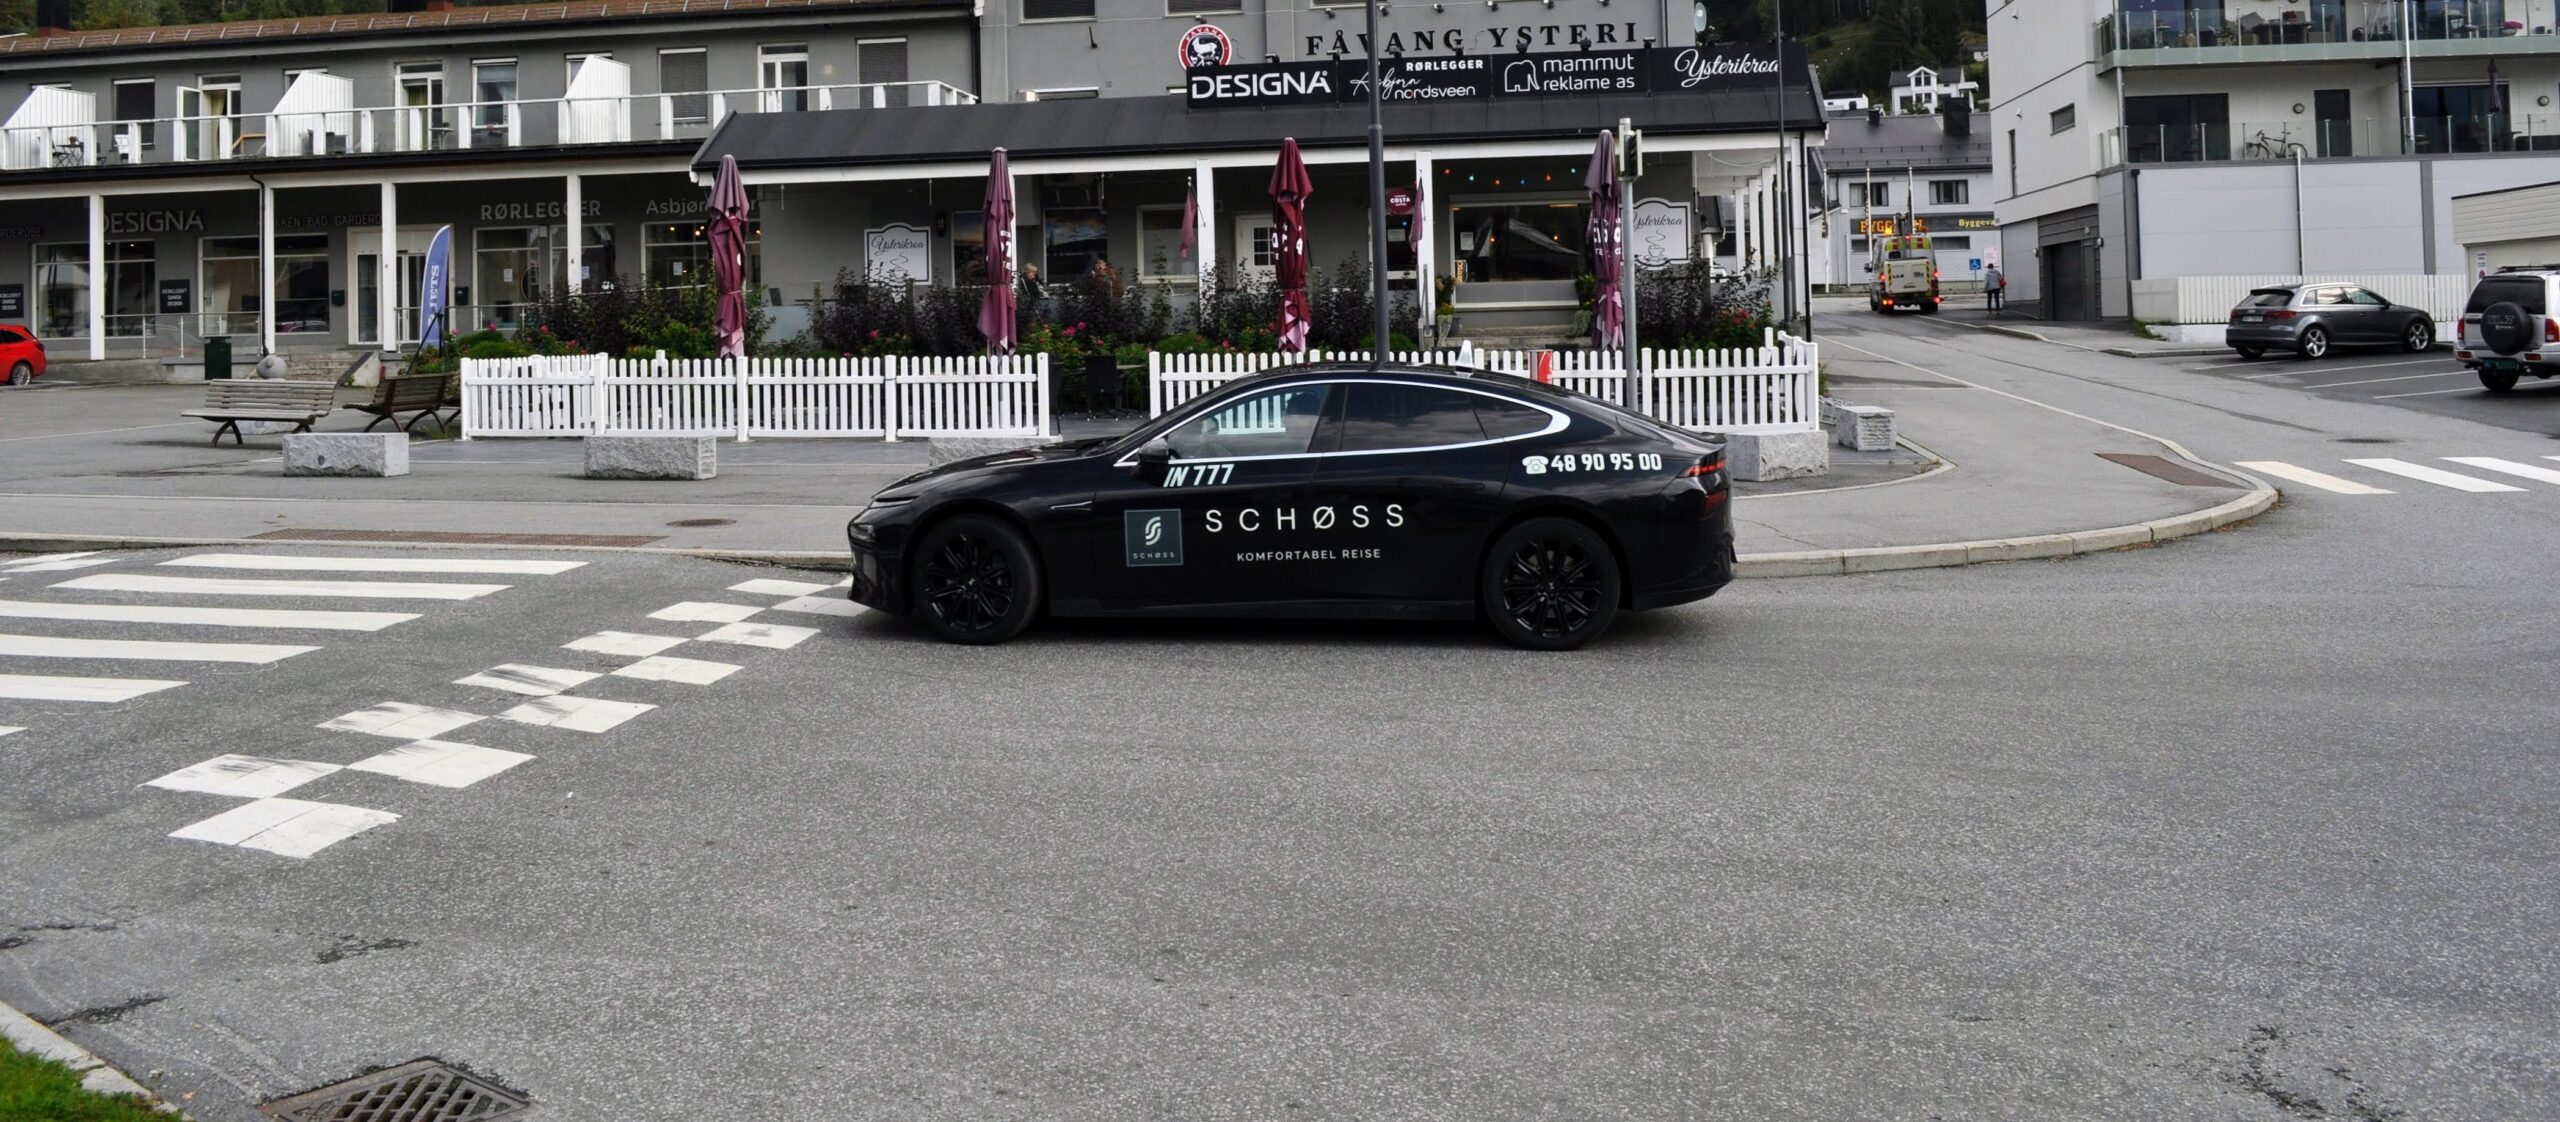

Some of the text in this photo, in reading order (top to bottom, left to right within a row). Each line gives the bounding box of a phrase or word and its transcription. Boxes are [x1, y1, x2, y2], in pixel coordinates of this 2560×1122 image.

[1487, 22, 1636, 49] YSTERI
[1406, 60, 1484, 71] RØRLEGGER
[1543, 53, 1636, 73] mammut
[1674, 49, 1779, 88] Ysterikroa
[1394, 85, 1476, 99] nordsveen
[1543, 75, 1636, 91] reklame as
[481, 200, 601, 220] RØRLEGER
[871, 235, 925, 257] Ysterikroa
[1551, 453, 1662, 472] 48 90 95 00
[1163, 463, 1235, 488] IN 777
[1205, 503, 1404, 533] SCHØSS
[1237, 548, 1381, 562] KOMFORTABEL REISE
